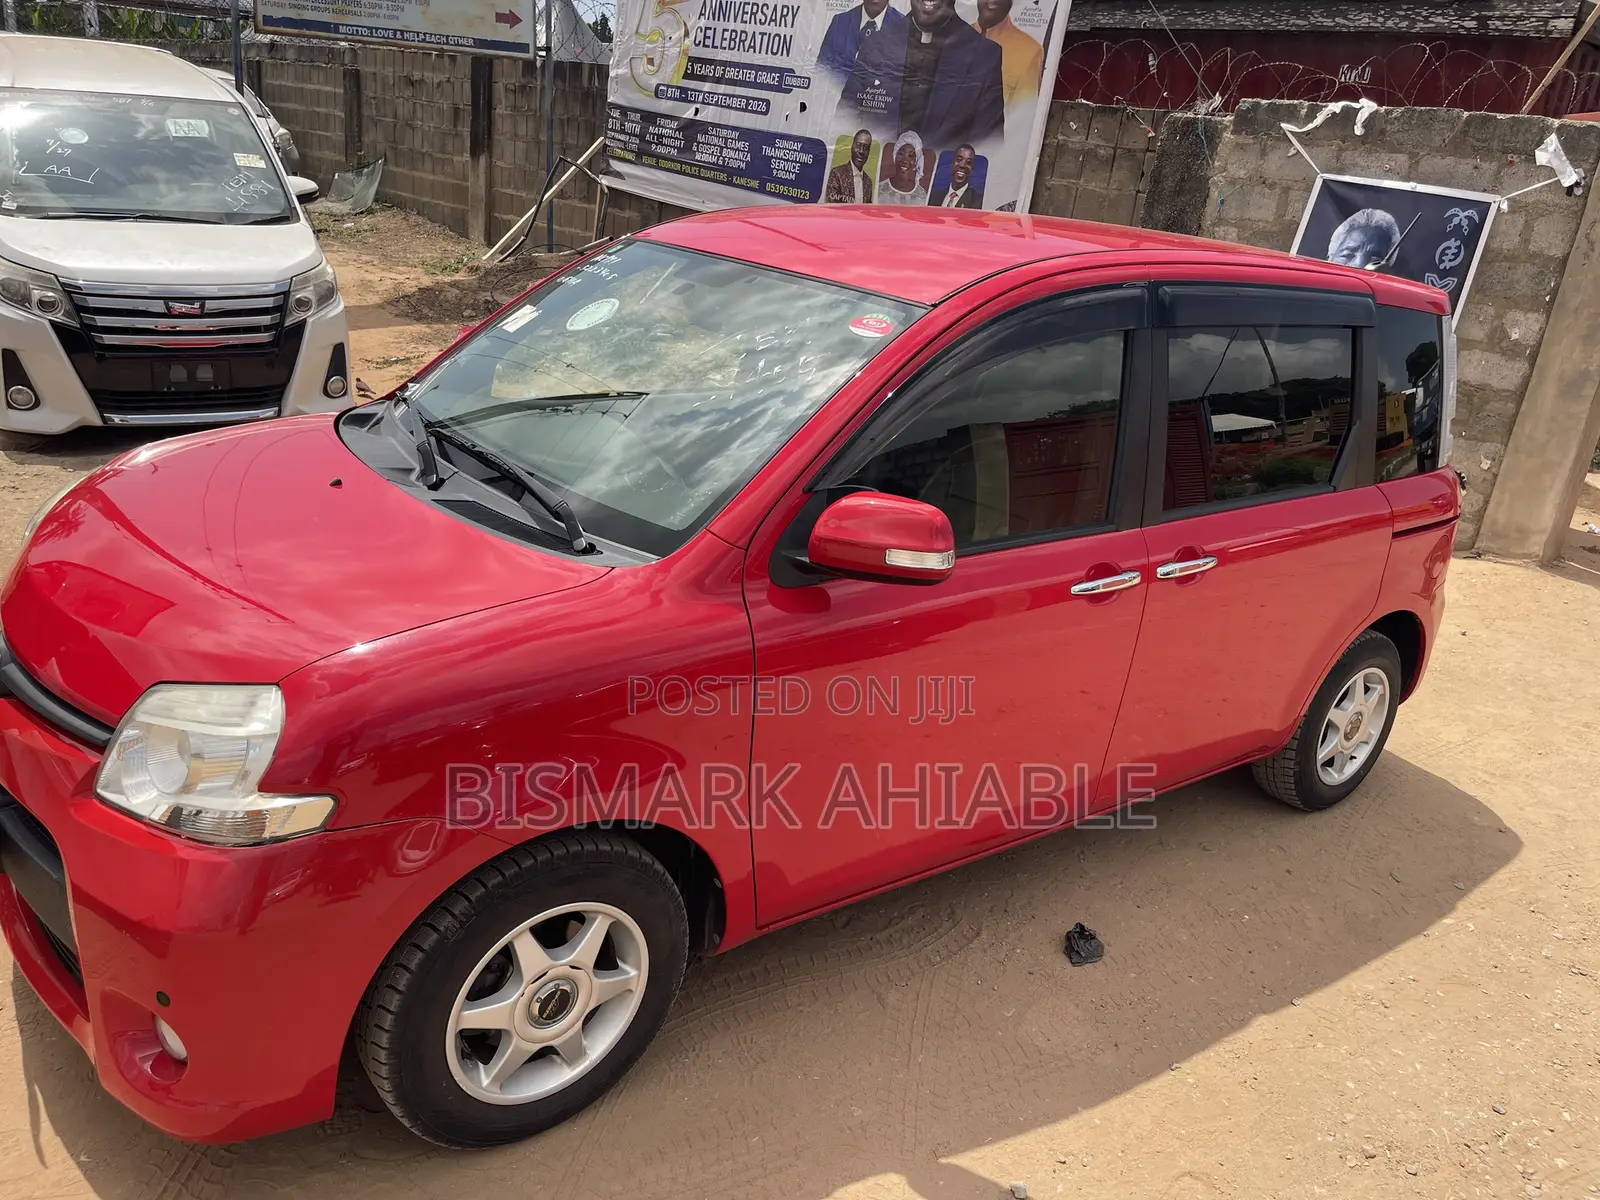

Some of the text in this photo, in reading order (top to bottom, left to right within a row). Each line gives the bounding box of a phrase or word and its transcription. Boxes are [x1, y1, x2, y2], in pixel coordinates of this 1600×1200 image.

[288, 3, 309, 11] SINGING
[311, 6, 331, 14] GROUPS
[698, 0, 800, 28] ANNIVERSARY
[339, 25, 474, 46] MOTTO: LOVE & HELP EACH OTHER
[693, 26, 793, 57] CELEBRATION
[687, 63, 808, 88] 5 YEARS OF GREATER GRACE DUBBED
[667, 88, 680, 99] 8TH
[687, 90, 705, 102] 13TH
[704, 93, 746, 109] SEPTEMBER
[748, 100, 768, 113] 2026
[857, 92, 875, 101] ISAAC
[862, 100, 886, 108] ESHUN
[656, 117, 678, 129] FRIDAY
[648, 126, 684, 139] NATIONAL
[707, 126, 740, 140] SATURDAY
[645, 134, 685, 148] ALL-NIGHT
[697, 133, 750, 151] NATIONAL GAMES
[775, 138, 803, 151] SUNDAY
[651, 143, 678, 156] 9:00PM
[692, 142, 751, 162] & GOSPEL BONANZA
[762, 145, 813, 164] THANKSGIVING
[718, 157, 723, 165] &
[770, 158, 801, 174] SERVICE
[43, 164, 72, 177] AA
[682, 164, 700, 175] POLICE
[700, 168, 728, 182] QUARTERS
[732, 175, 760, 189] KANESHIE
[773, 169, 796, 180] 9:00AM
[765, 182, 810, 200] 0539530123
